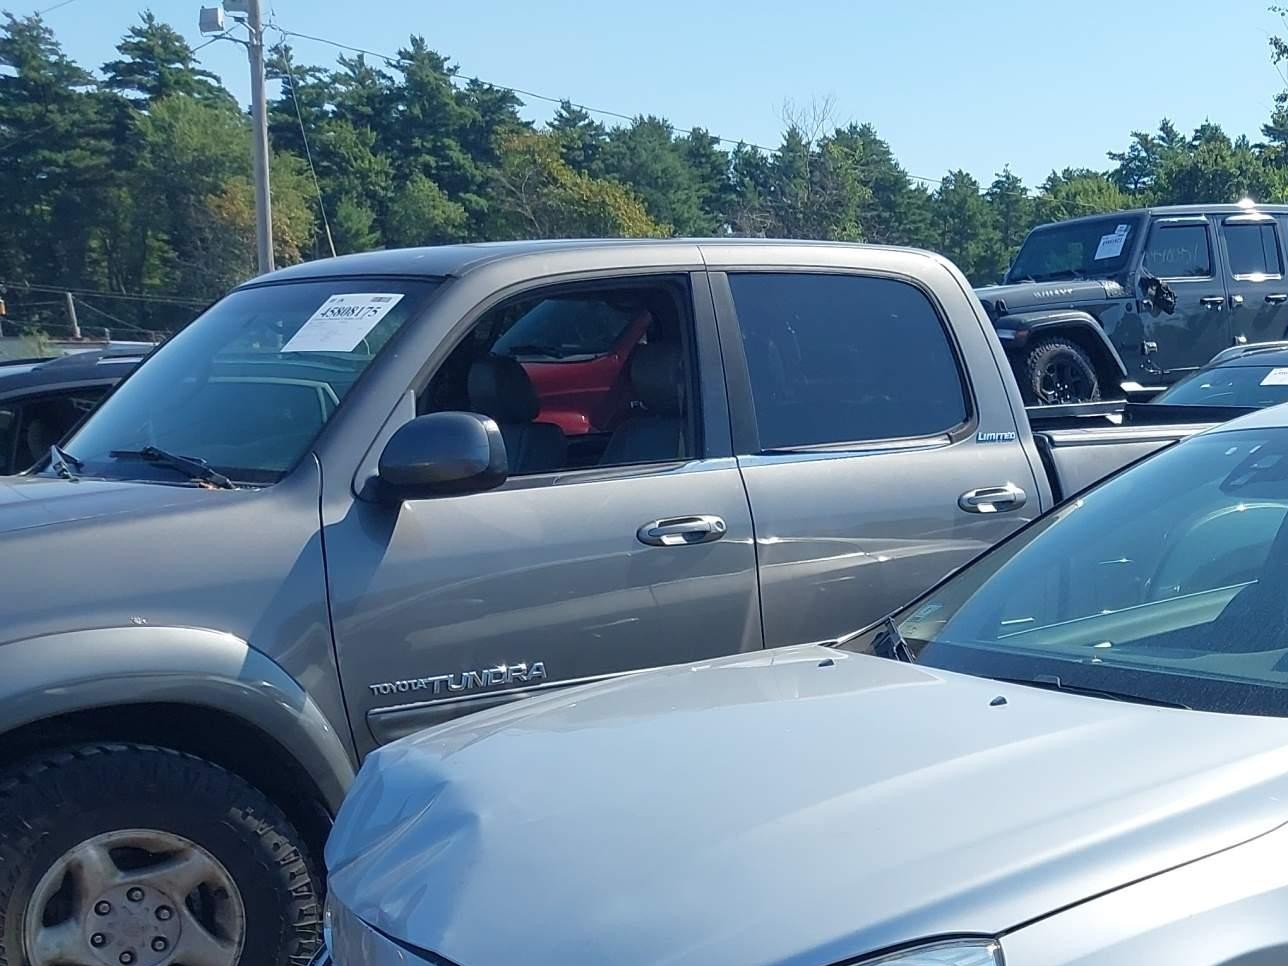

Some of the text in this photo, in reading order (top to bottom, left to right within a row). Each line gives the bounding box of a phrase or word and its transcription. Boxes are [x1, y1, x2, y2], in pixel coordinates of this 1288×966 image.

[320, 305, 381, 318] 45808175
[369, 662, 548, 695] TOYOTA TUNDRA
